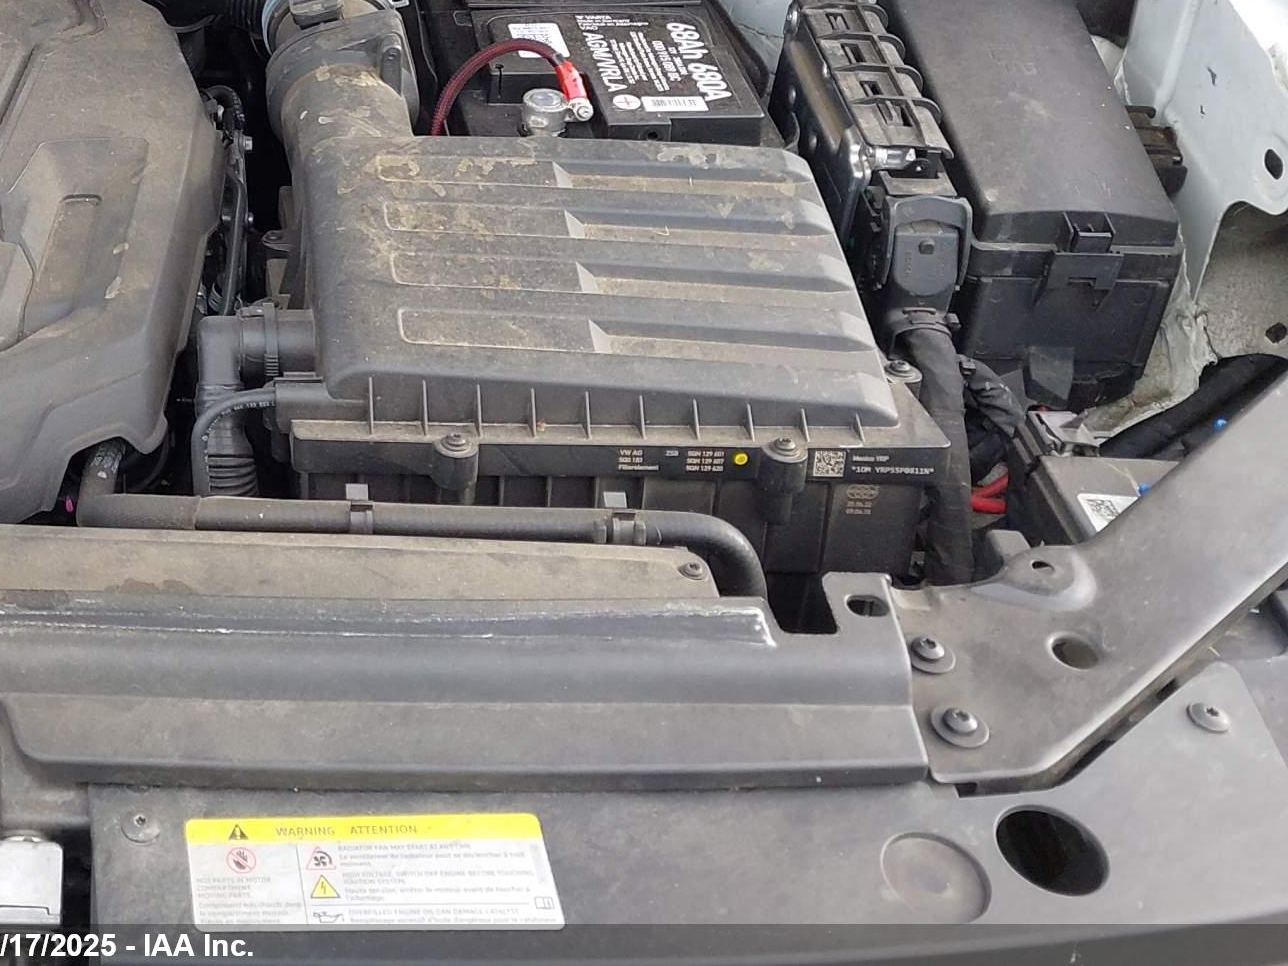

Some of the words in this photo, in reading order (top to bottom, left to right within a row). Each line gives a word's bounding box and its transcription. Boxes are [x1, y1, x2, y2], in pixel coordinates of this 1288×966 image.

[582, 31, 628, 92] AGM/VRLA
[665, 21, 709, 60] 68Ah
[687, 61, 732, 102] 680A
[275, 826, 336, 837] WARNING
[350, 824, 418, 836] ATTENTION
